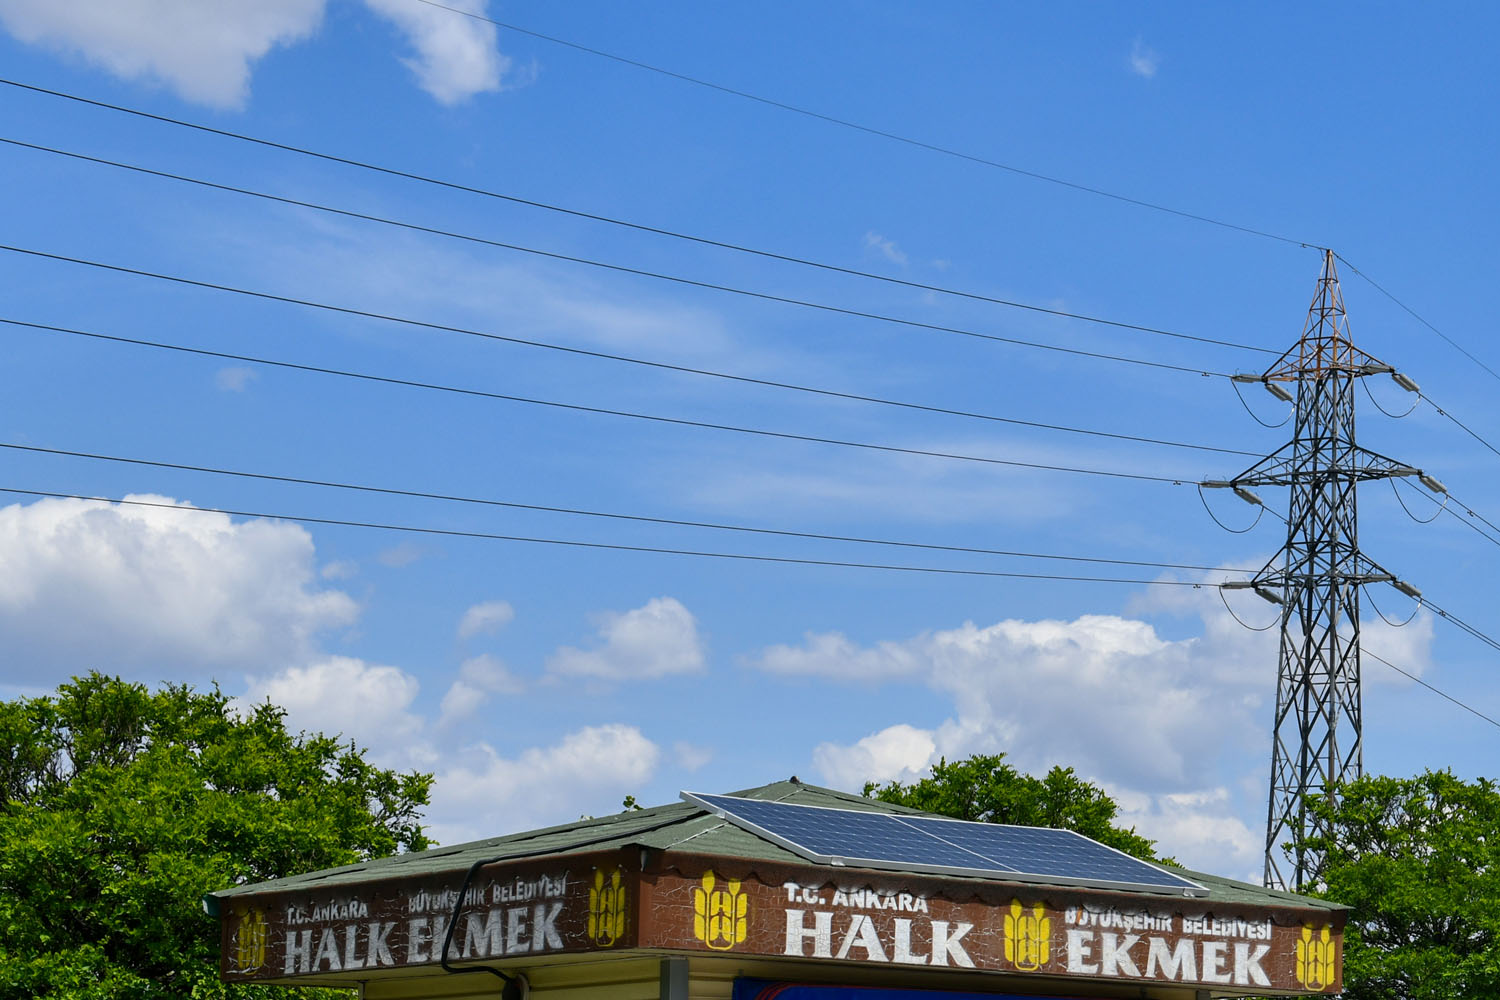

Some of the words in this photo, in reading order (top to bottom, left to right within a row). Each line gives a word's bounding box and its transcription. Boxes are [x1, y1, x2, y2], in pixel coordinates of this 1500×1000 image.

[312, 900, 369, 922] ANKARA
[783, 882, 826, 905] T.C.
[832, 888, 929, 914] ANKARA
[284, 921, 399, 974] HALK
[406, 901, 564, 964] EKMEK
[784, 908, 977, 968] HALK
[1066, 929, 1272, 987] EKMEK
